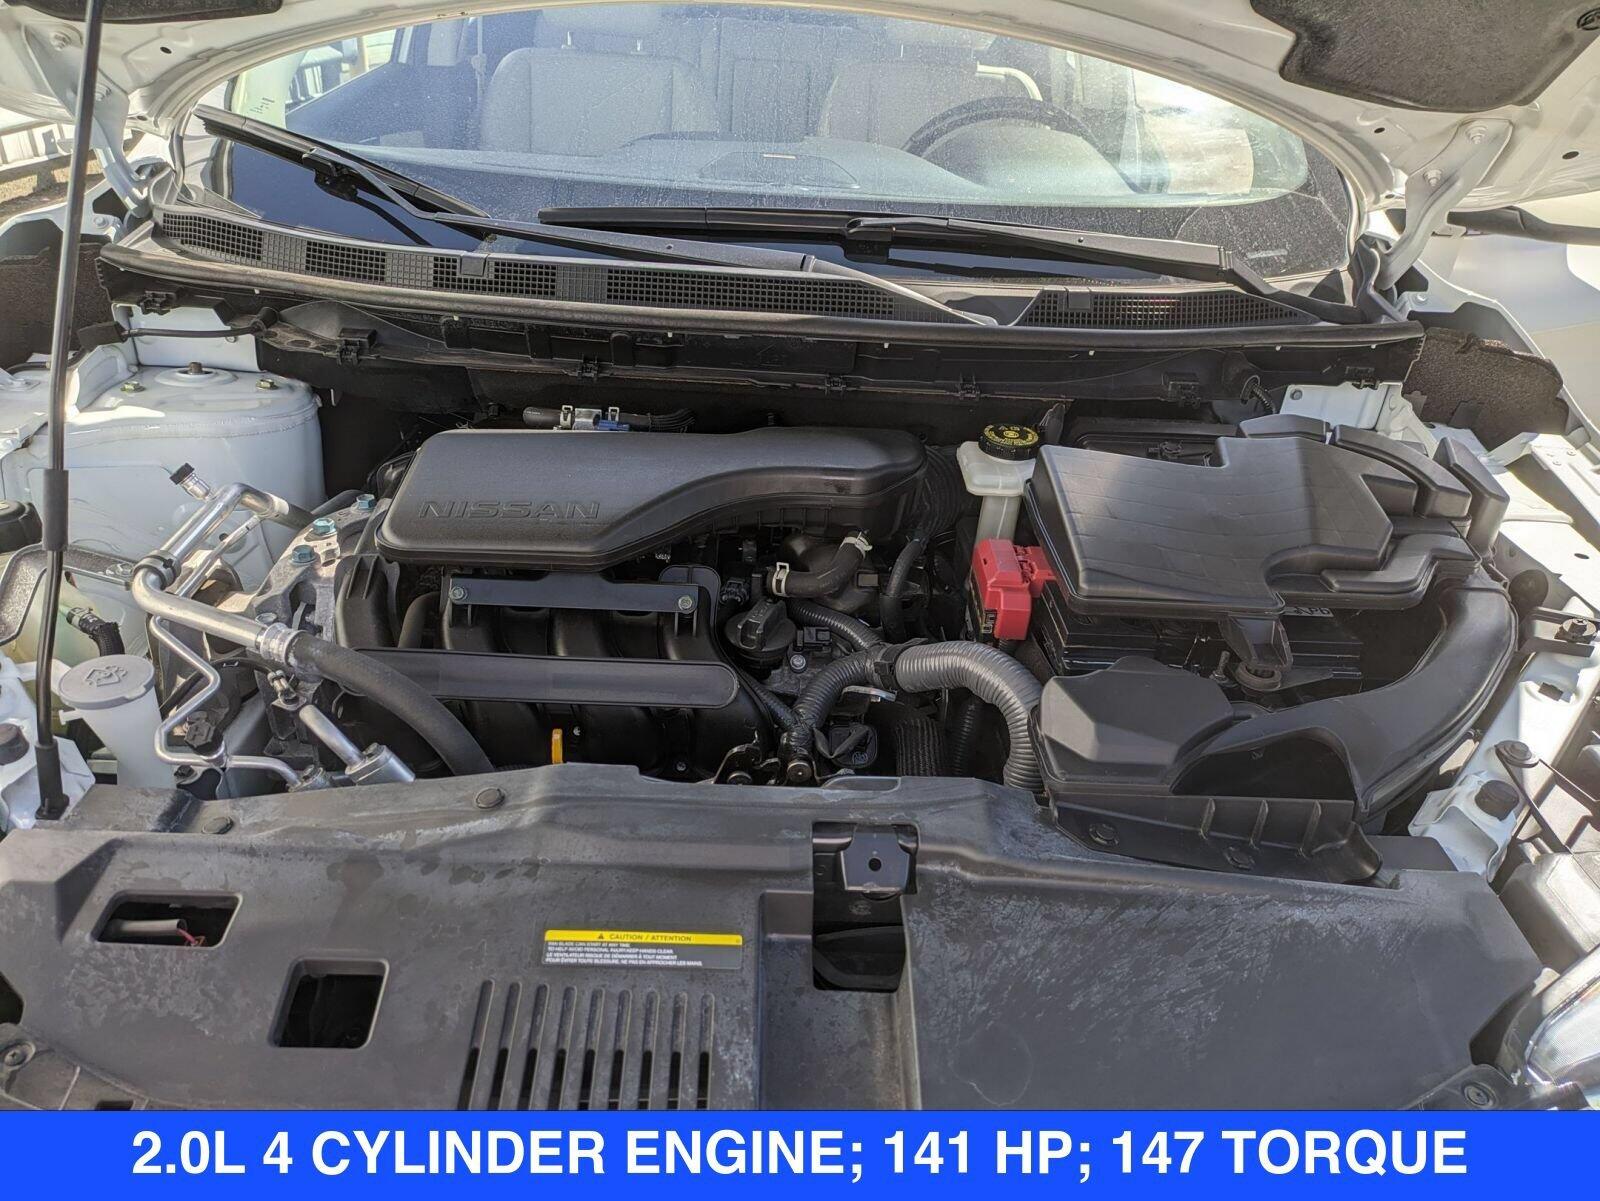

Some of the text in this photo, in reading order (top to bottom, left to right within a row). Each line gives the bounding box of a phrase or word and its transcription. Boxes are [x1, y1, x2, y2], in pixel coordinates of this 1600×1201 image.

[419, 501, 600, 519] NISSAN
[610, 933, 644, 941] CAUTION
[650, 934, 692, 942] ATTENTION
